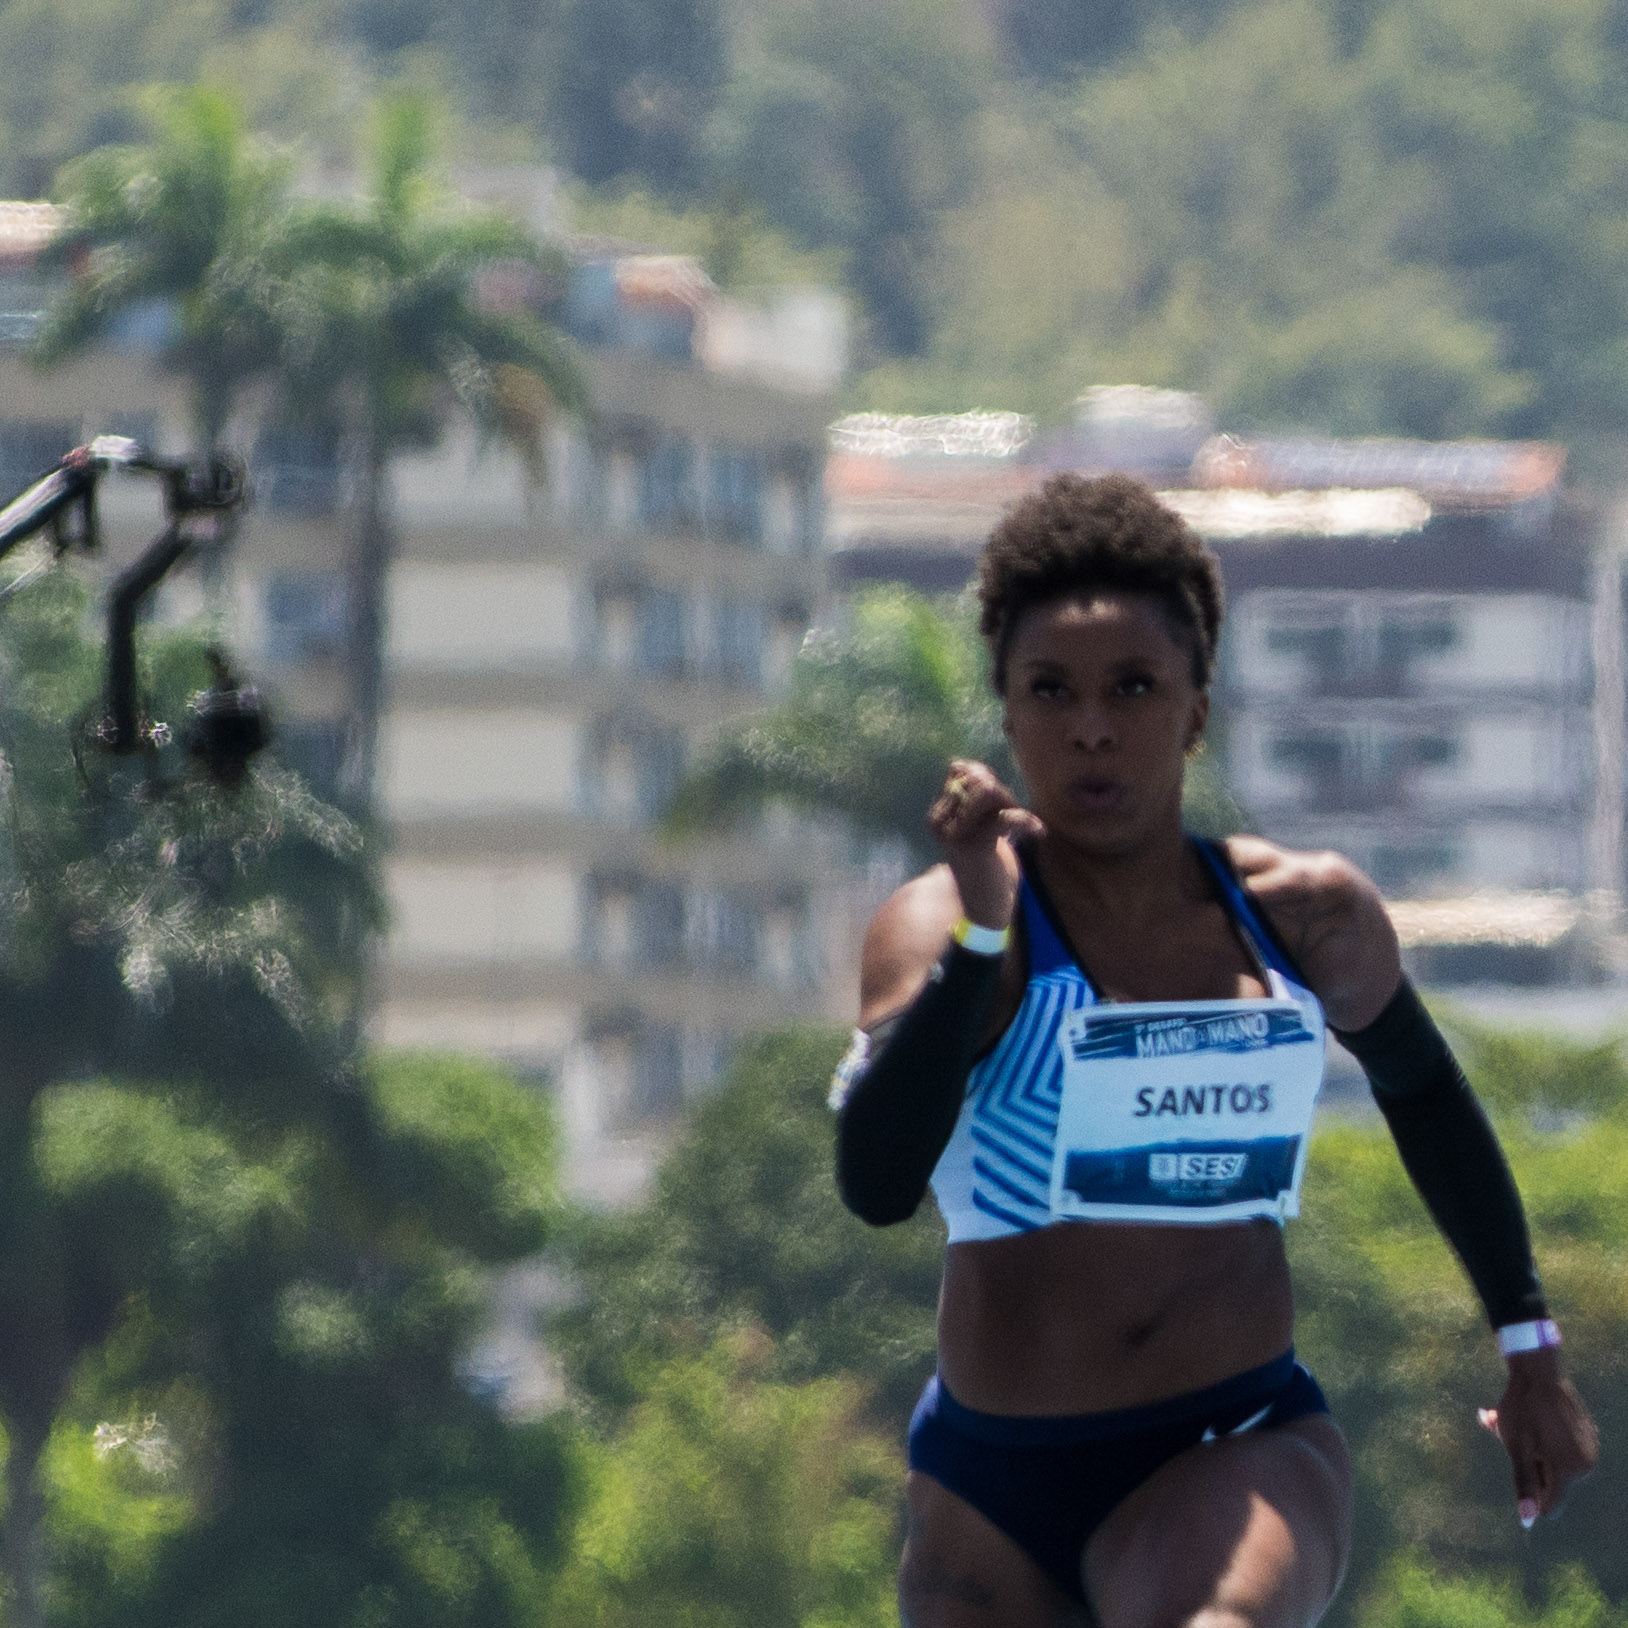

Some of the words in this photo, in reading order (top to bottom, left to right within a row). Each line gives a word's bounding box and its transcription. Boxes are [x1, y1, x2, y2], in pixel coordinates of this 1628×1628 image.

[1136, 1027, 1200, 1058] MANO
[1207, 1012, 1270, 1045] MANO
[1133, 1083, 1272, 1118] SANTOS
